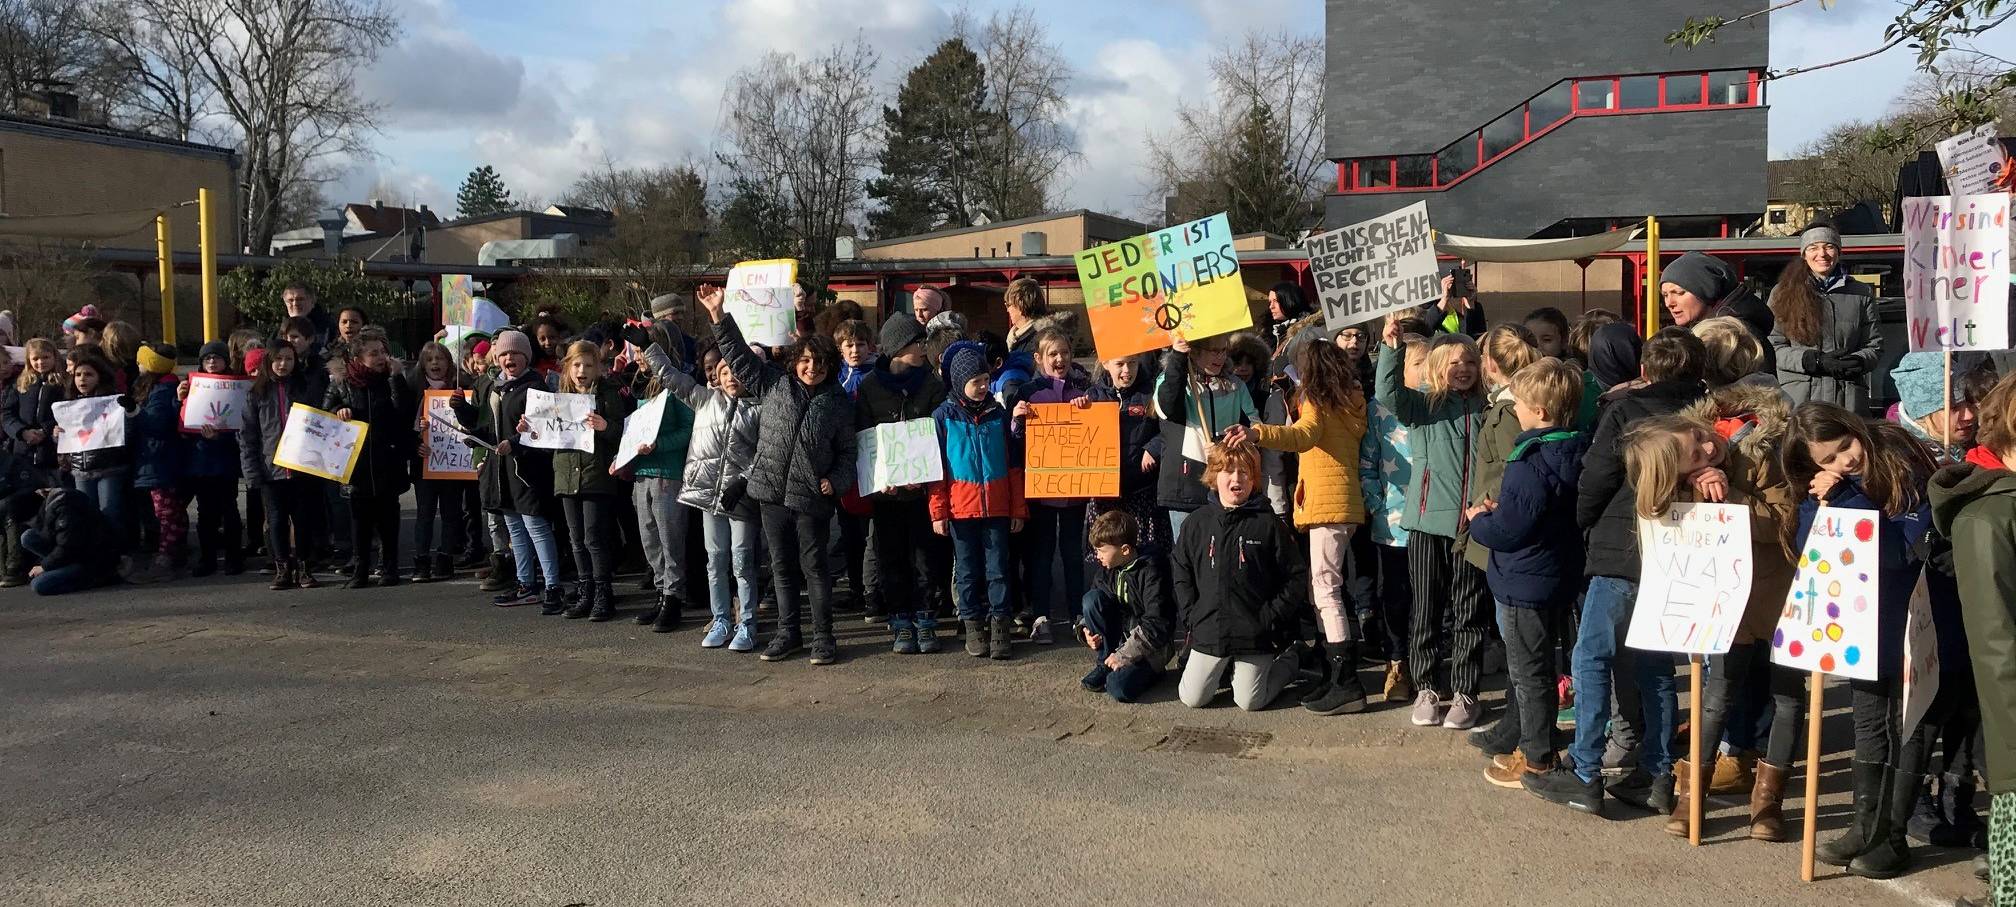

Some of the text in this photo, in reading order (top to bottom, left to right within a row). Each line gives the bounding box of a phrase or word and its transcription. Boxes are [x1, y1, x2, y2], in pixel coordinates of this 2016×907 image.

[1905, 201, 2006, 231] Wir sind
[1082, 218, 1214, 280] JEDER IST
[1307, 210, 1429, 258] MENSCHEN-
[1312, 231, 1429, 273] RECHTE STATT
[1908, 236, 2003, 273] Kinder
[1091, 243, 1239, 307] BESONDERS
[1316, 258, 1398, 293] RECHTE
[1906, 273, 1990, 304] einer
[1326, 272, 1443, 320] MENSCHEN
[1911, 317, 1977, 349] Welt
[432, 398, 447, 410] DIE
[1030, 404, 1082, 425] ALLE
[545, 416, 588, 433] NAZIS
[1033, 425, 1100, 446] HABEN
[430, 451, 474, 469] NAZIS!
[1027, 444, 1118, 469] GLEICHE
[865, 455, 930, 491] NZIS!
[1033, 471, 1118, 496] RECHTE
[1662, 579, 1731, 620] ER
